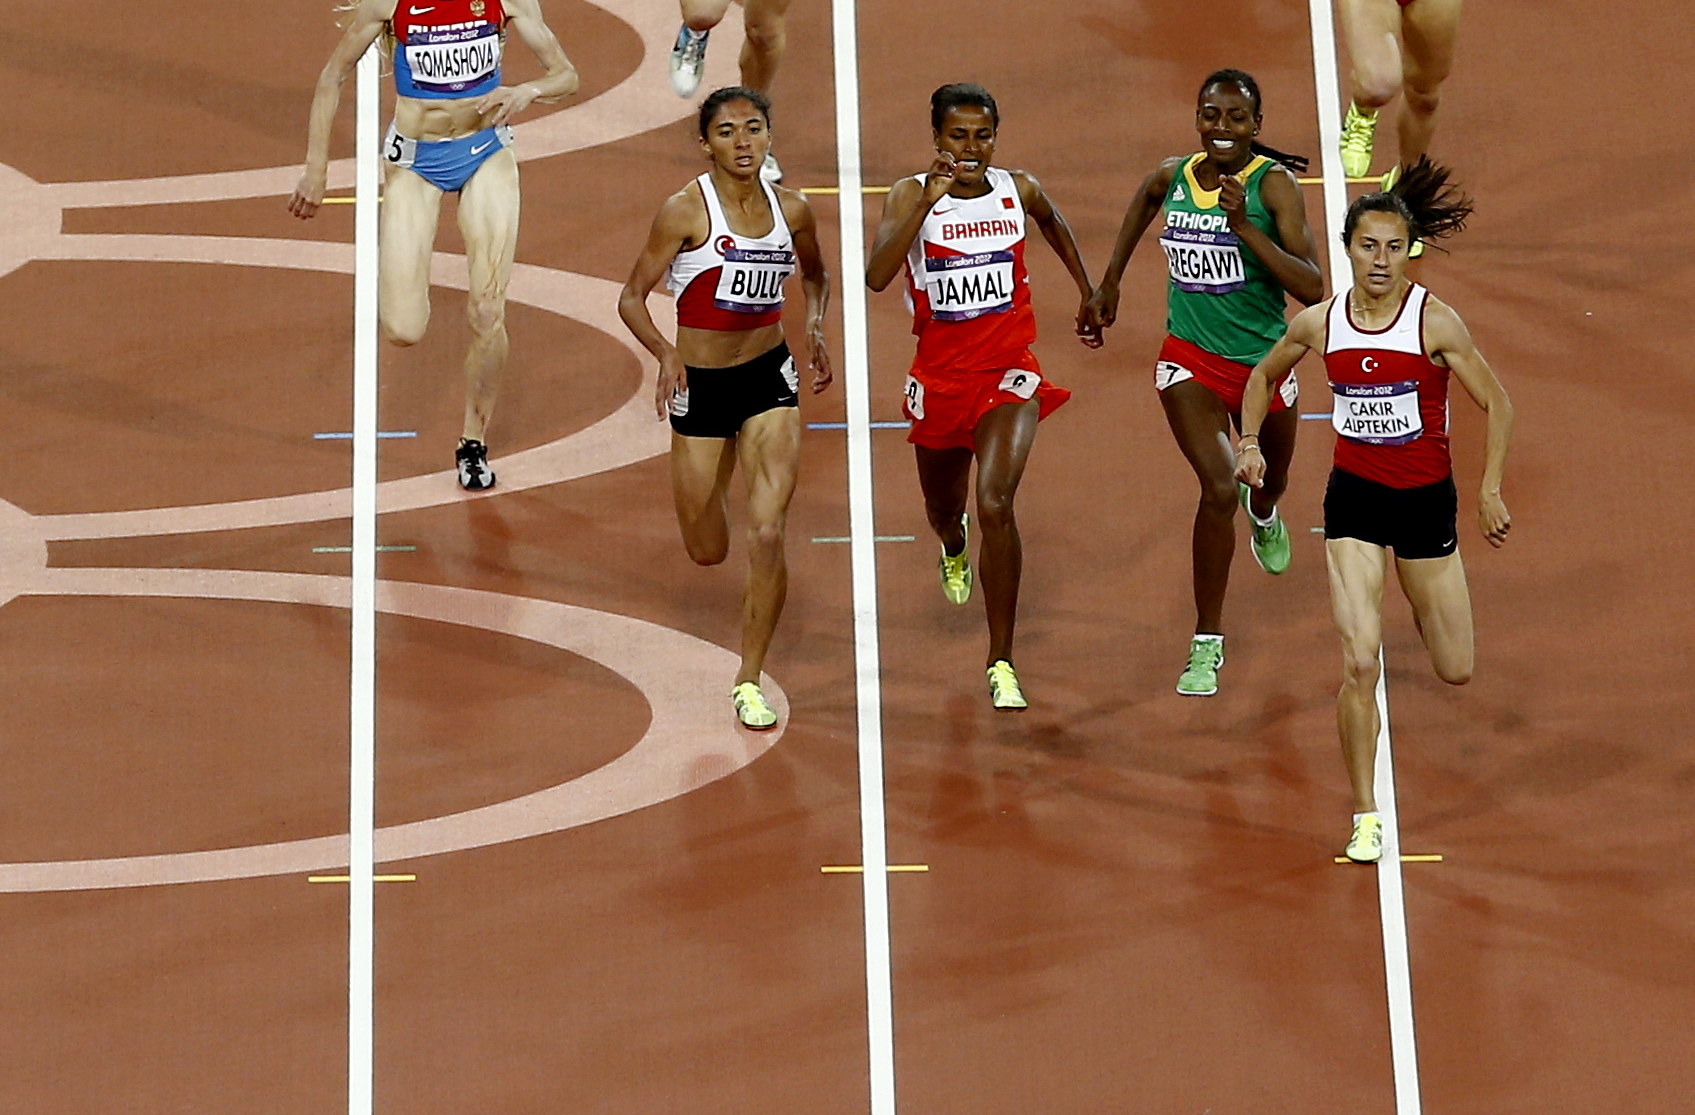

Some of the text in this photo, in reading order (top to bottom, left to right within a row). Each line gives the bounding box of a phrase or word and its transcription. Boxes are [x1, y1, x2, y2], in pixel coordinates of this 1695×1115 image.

[428, 29, 479, 43] London 2012
[415, 42, 493, 79] TOMASHOVA
[388, 134, 404, 163] 5
[942, 219, 1019, 241] BAHRAIN
[1166, 210, 1231, 233] ETHIOPI
[1172, 230, 1198, 241] London
[945, 256, 974, 268] London
[730, 269, 790, 299] BULUT
[936, 270, 1008, 305] JAMAL
[1165, 364, 1181, 385] 7
[1345, 385, 1394, 396] London 2012
[1349, 401, 1394, 416] CAKIR
[1341, 415, 1410, 434] ALPTEKIN
